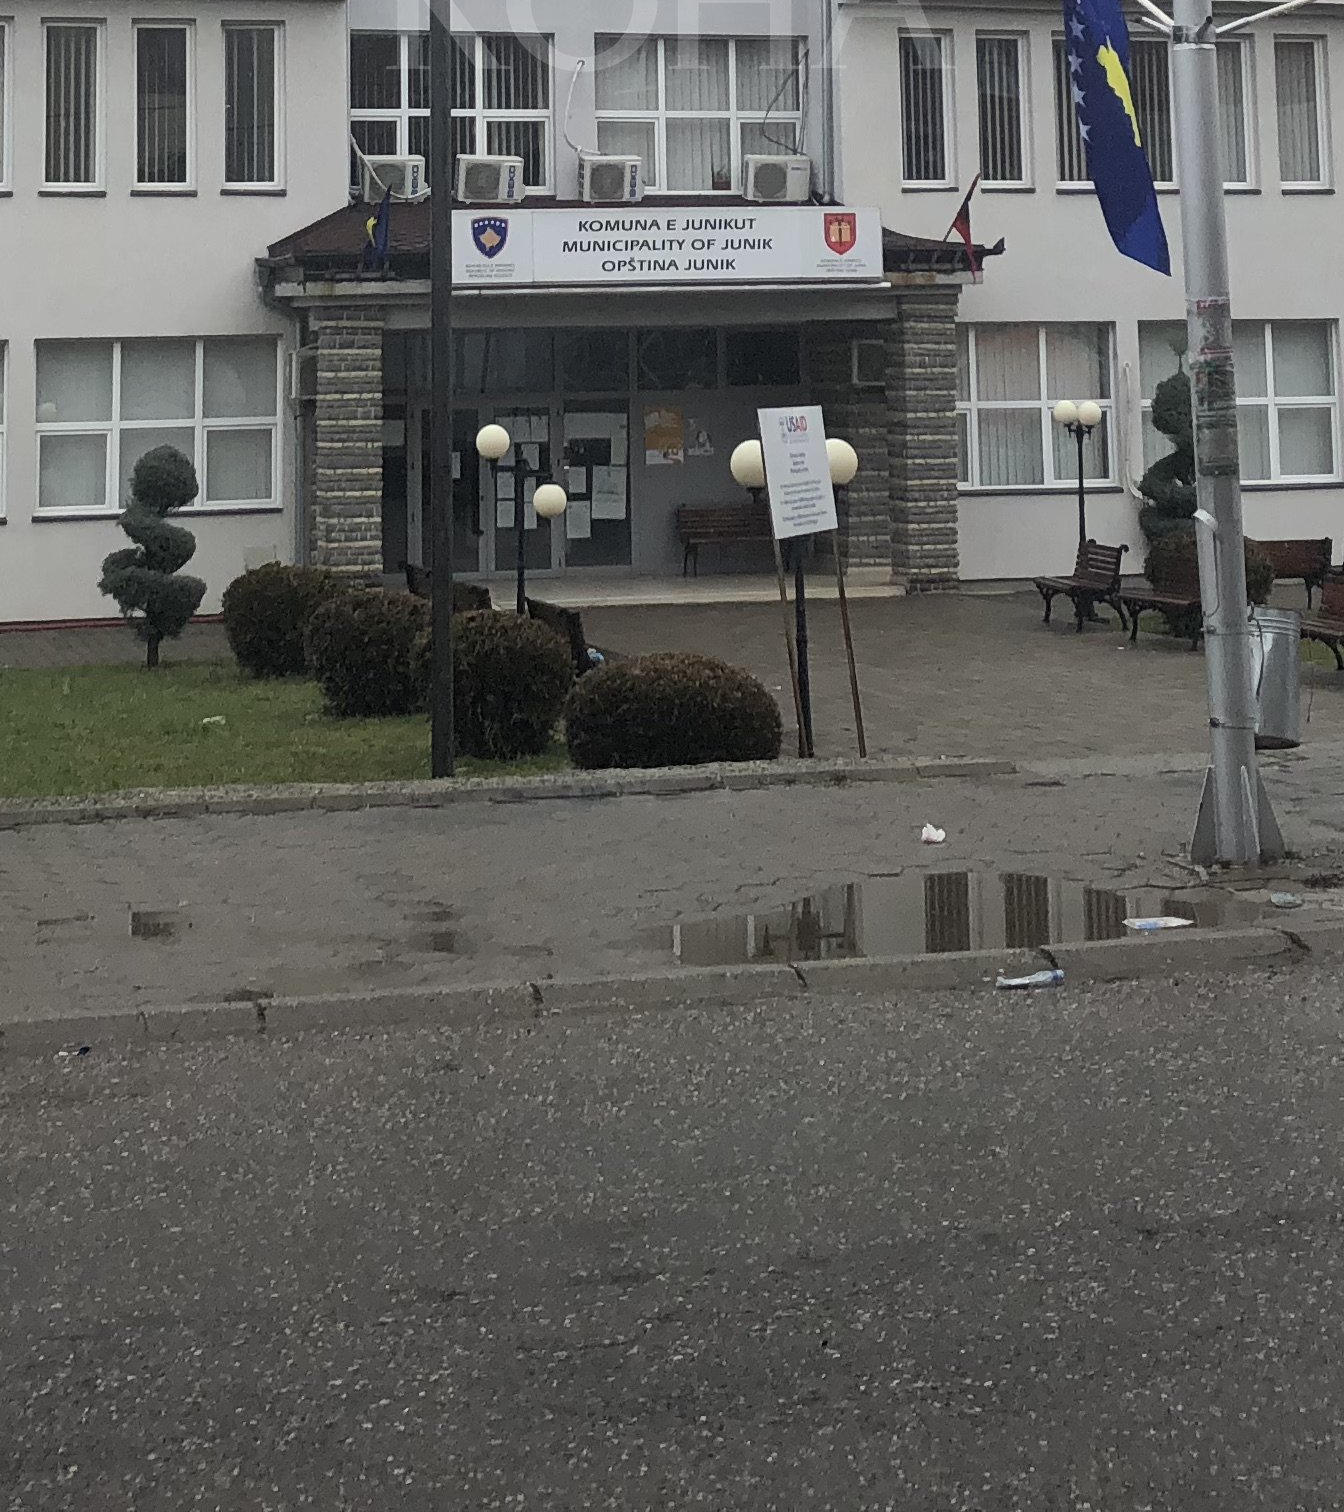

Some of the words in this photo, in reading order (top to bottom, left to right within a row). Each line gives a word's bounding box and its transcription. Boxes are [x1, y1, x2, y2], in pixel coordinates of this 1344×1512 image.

[578, 219, 661, 232] KOMUNA
[666, 219, 677, 231] E
[682, 218, 756, 231] JUNIKUT
[562, 239, 686, 253] MUNICIPALITY
[691, 239, 716, 251] OF
[721, 238, 773, 250] JUNIK
[601, 257, 680, 272] OPŠTINA
[684, 258, 736, 271] JUNIK
[785, 415, 808, 432] USAID
